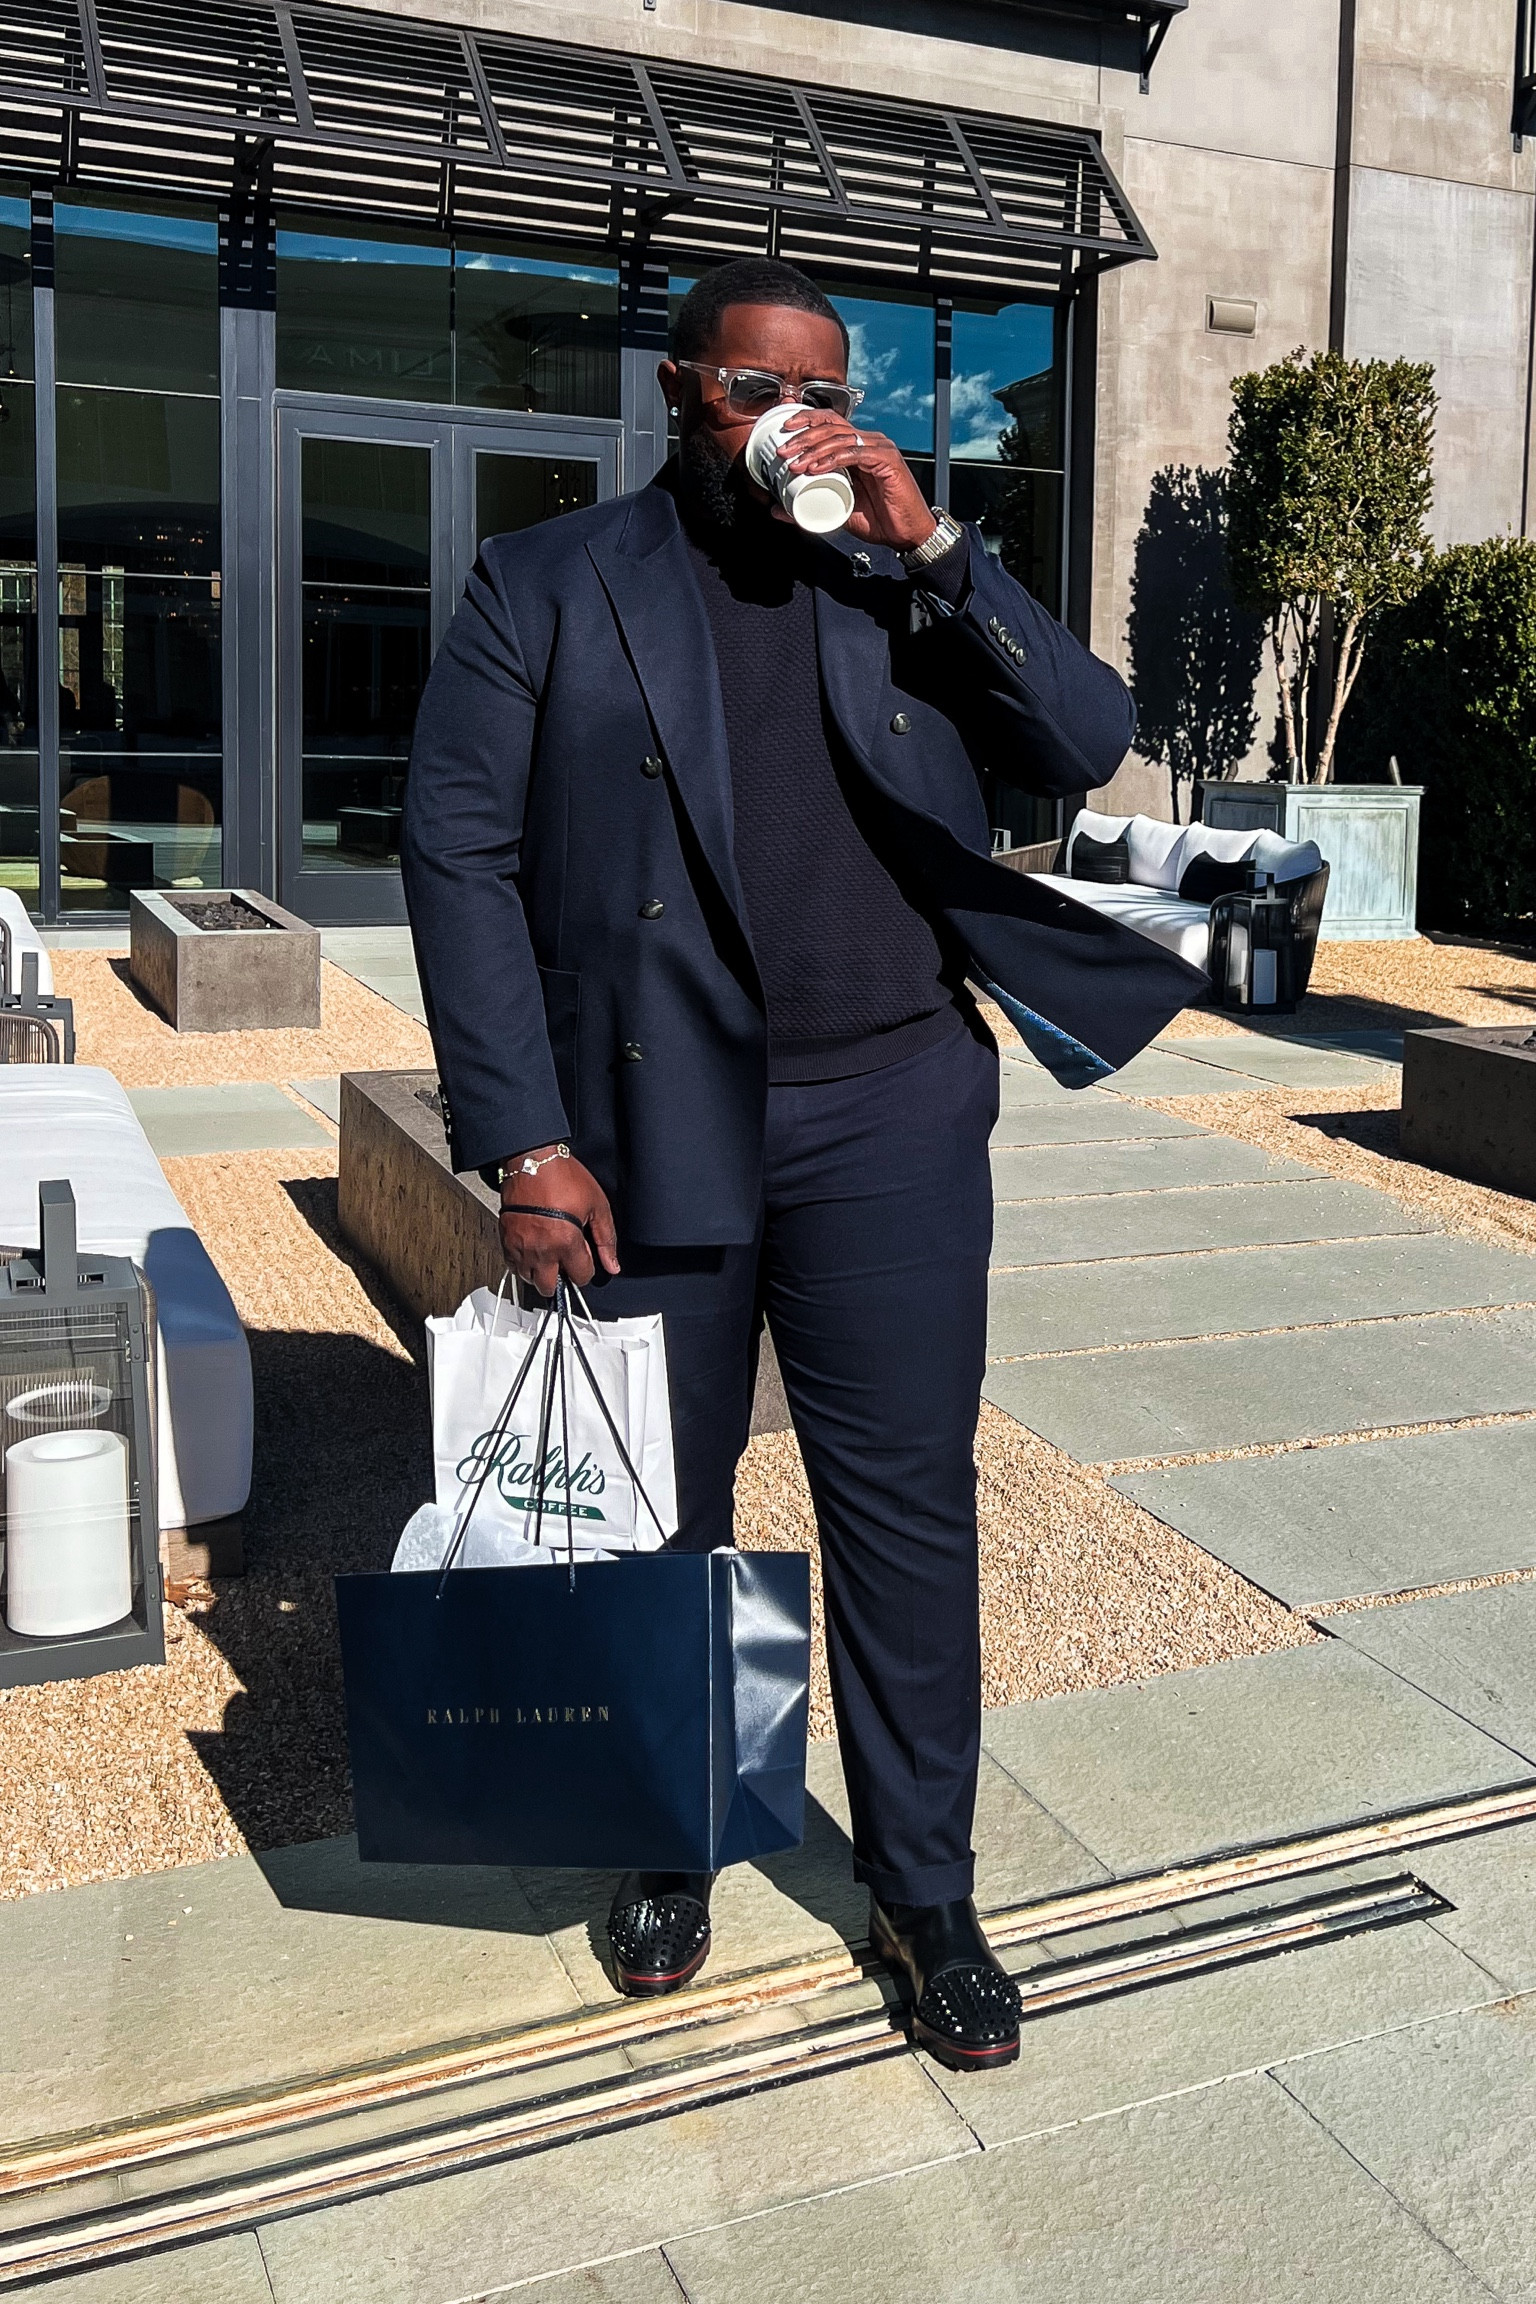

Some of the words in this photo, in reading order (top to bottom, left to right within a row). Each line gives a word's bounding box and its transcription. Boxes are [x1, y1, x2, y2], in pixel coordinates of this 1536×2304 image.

[456, 1429, 605, 1495] Ralph's
[427, 1708, 500, 1724] RALPH
[516, 1706, 609, 1723] LAUREN
